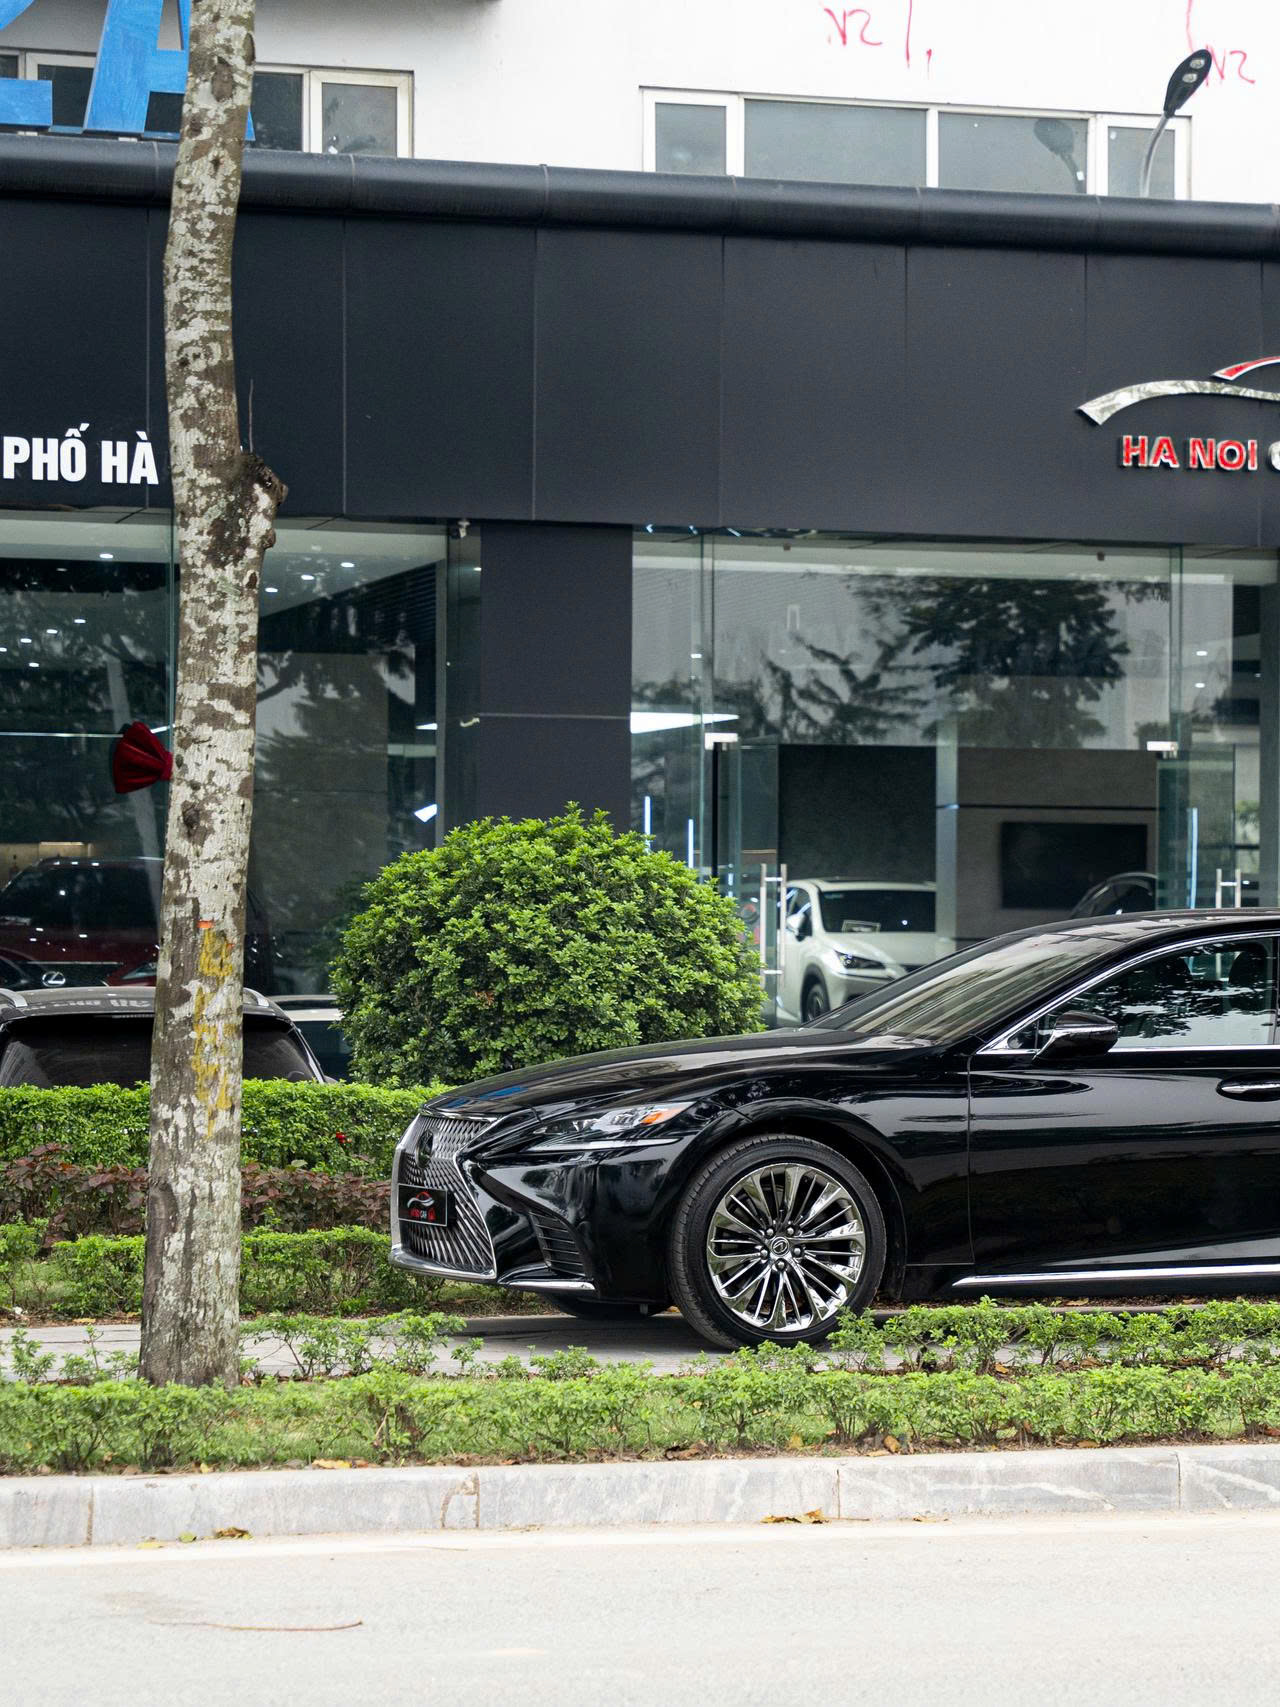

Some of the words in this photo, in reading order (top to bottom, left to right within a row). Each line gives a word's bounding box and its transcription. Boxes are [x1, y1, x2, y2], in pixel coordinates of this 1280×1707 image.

[3, 423, 90, 482] PHỐ
[101, 430, 159, 485] HÀ
[1122, 434, 1180, 468] HA
[1189, 437, 1258, 470] NOI
